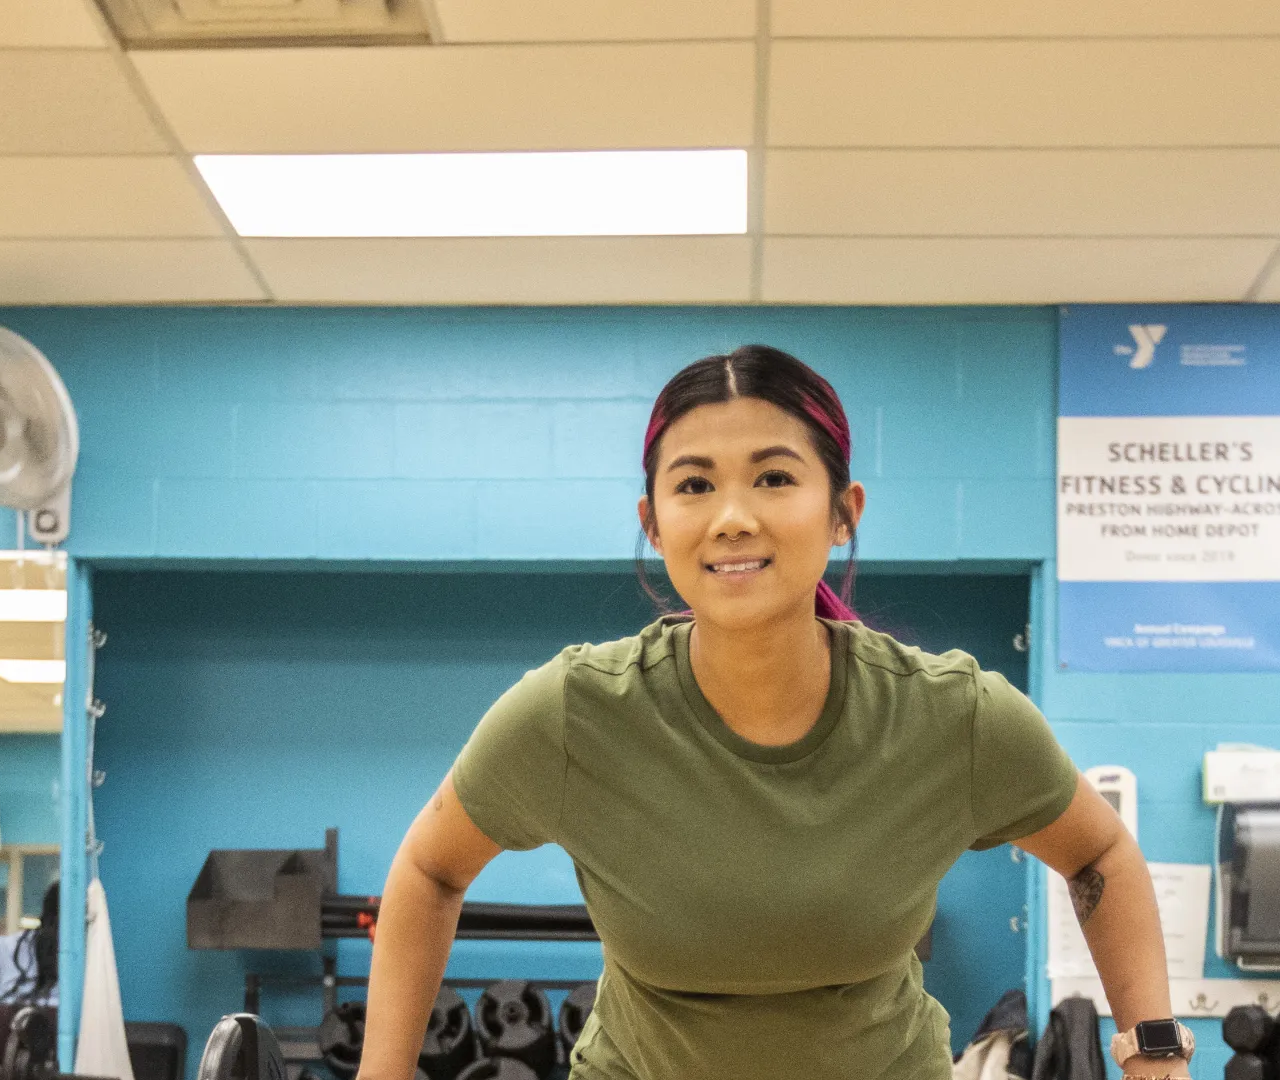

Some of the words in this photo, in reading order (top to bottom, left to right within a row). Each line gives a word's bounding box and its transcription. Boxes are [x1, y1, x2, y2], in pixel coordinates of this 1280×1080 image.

[1107, 441, 1253, 464] SCHELLER'S
[1060, 474, 1162, 496] FITNESS
[1170, 474, 1187, 496] &
[1065, 502, 1142, 517] PRESTON
[1100, 523, 1147, 538] FROM
[1151, 523, 1199, 538] HOME
[1204, 523, 1260, 538] DEPOT
